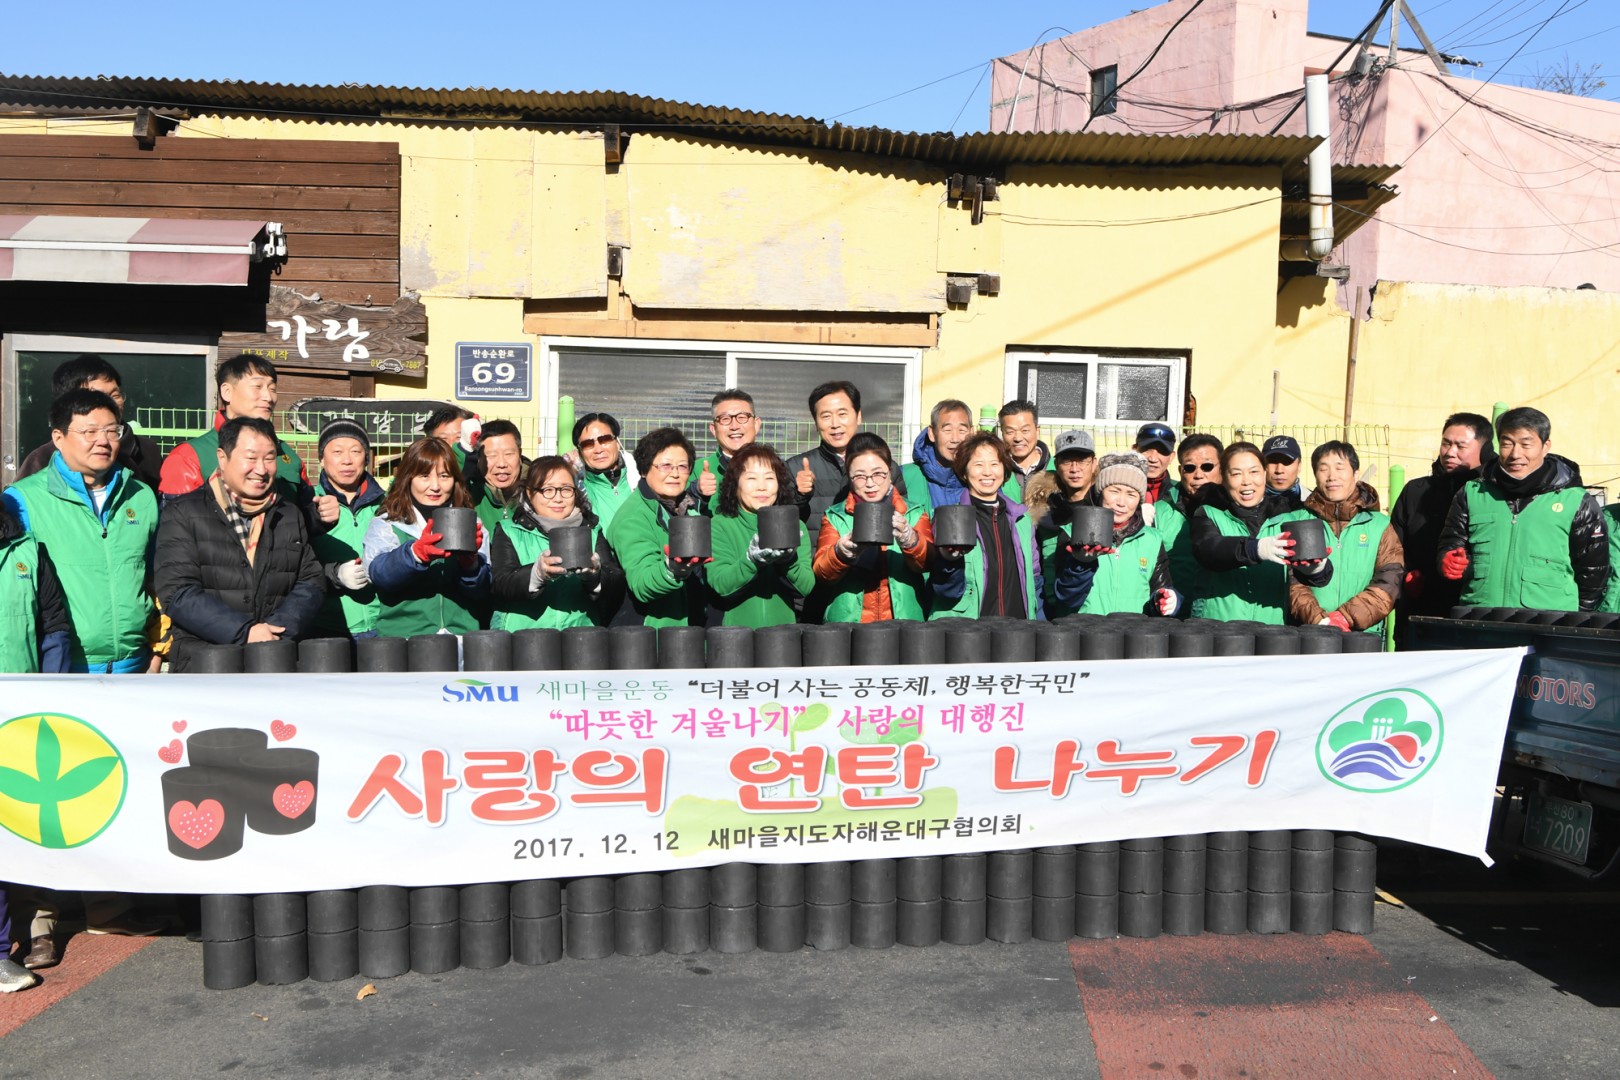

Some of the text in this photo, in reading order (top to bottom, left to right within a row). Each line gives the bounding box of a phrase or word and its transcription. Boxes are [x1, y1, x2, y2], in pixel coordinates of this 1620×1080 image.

[267, 314, 370, 363] 가람
[472, 349, 515, 359] 반송순환로
[471, 362, 516, 384] 69
[442, 682, 519, 703] SMU
[536, 680, 674, 701] 새마을운동
[788, 678, 843, 699] 사는
[849, 675, 936, 698] 공동체,
[836, 704, 925, 737] 사랑의
[940, 702, 1025, 735] 대행진
[346, 729, 1280, 826] 사랑의 연탄 나누기
[513, 814, 1023, 860] 2017. 12. 12 새마을지도자해운대구협의회
[1543, 817, 1585, 856] 7209
